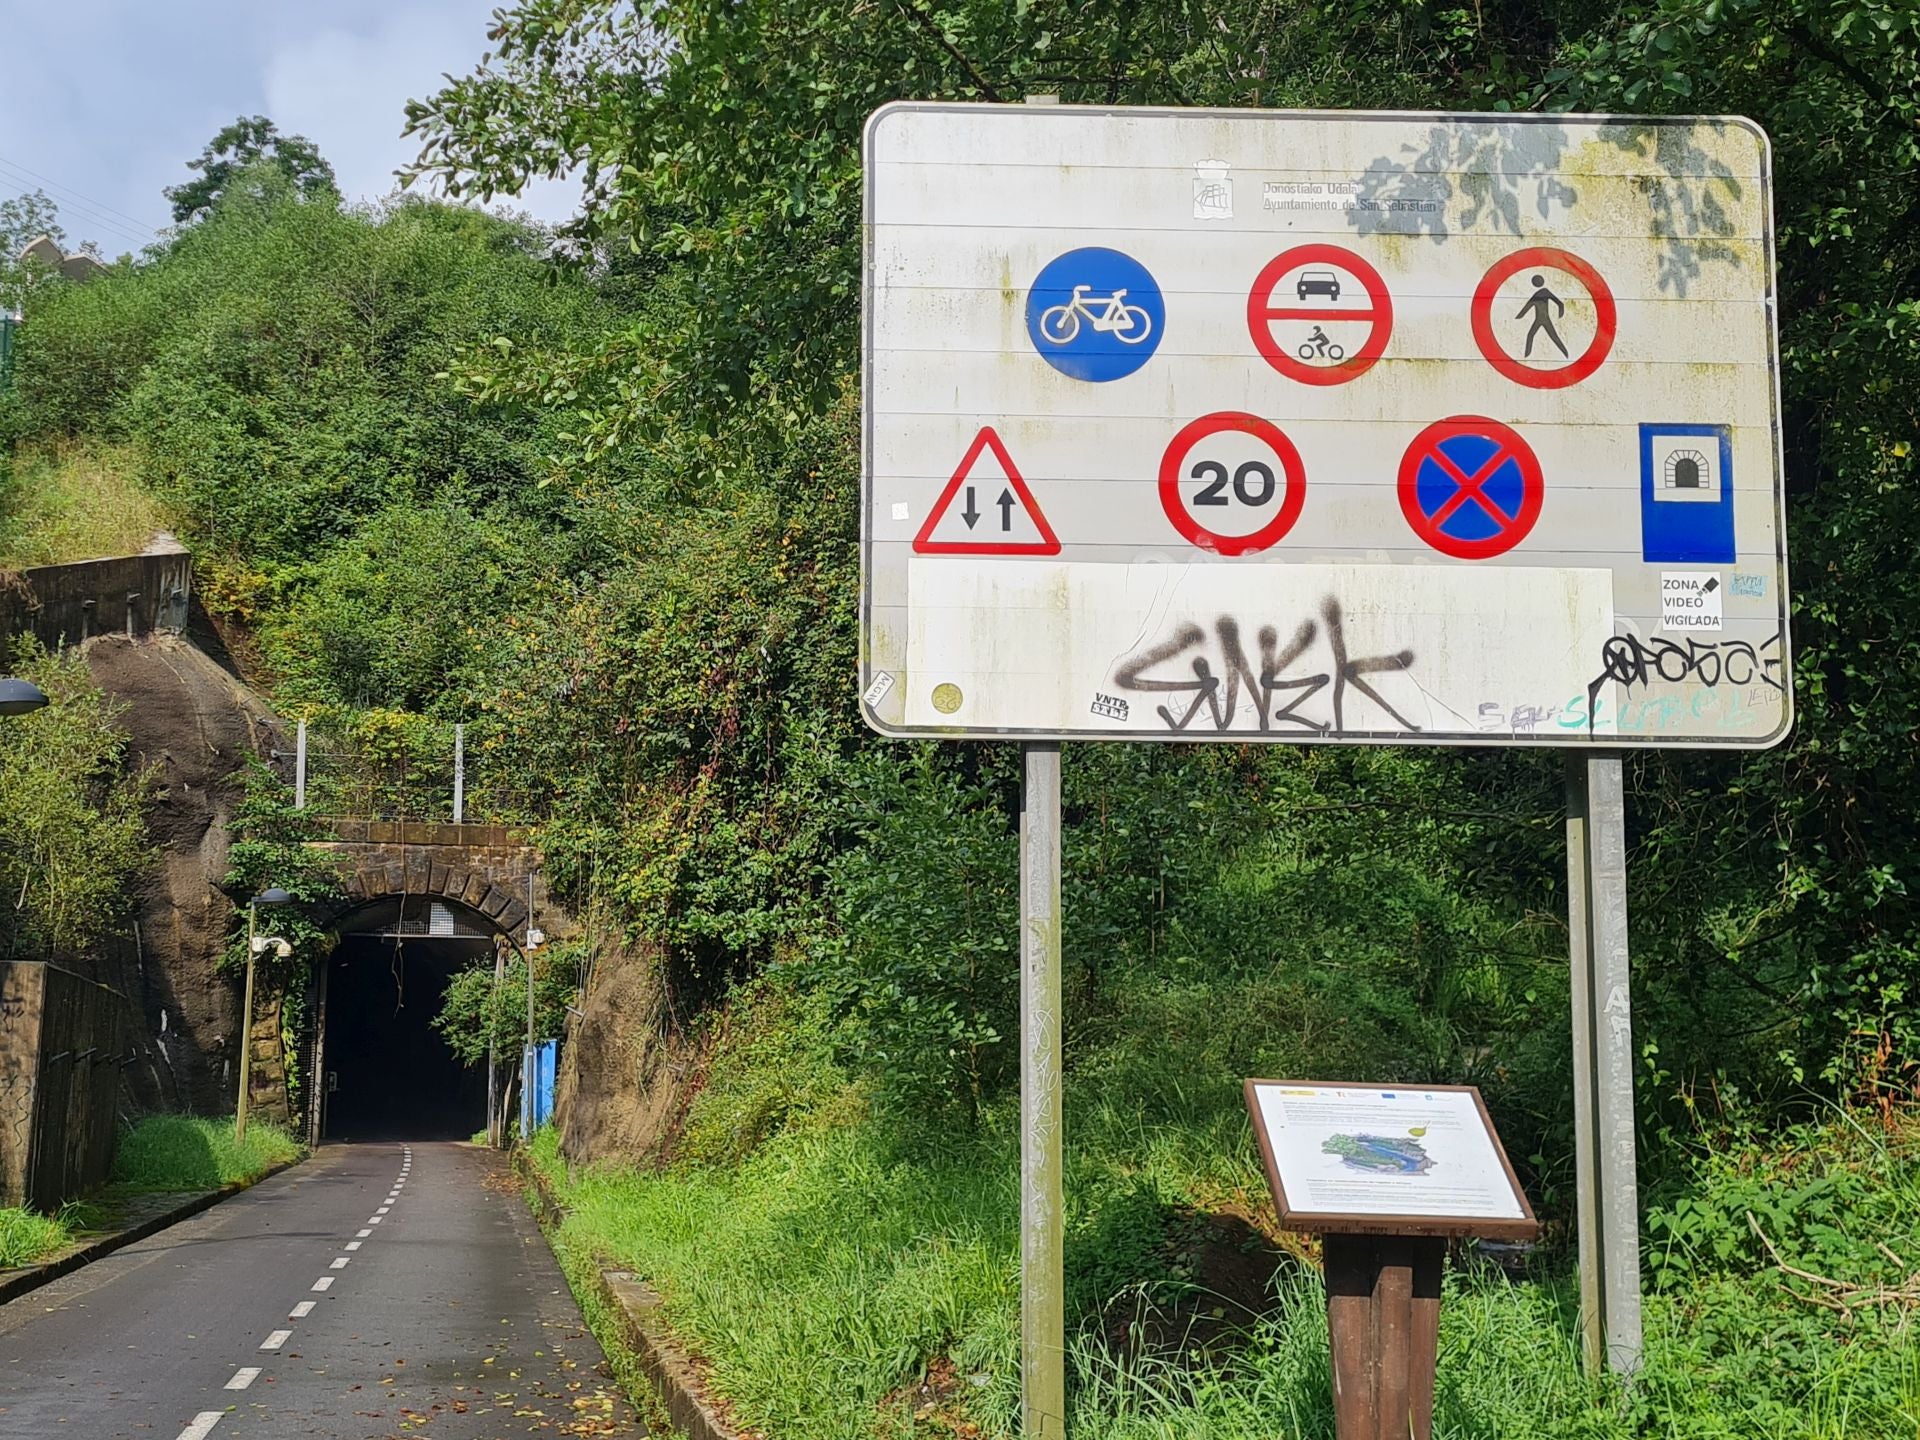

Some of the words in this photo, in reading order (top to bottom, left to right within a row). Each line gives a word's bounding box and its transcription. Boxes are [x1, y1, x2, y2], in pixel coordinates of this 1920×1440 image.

[1263, 182, 1323, 194] Donostiako
[1264, 198, 1337, 214] Ayuntamiento
[1342, 198, 1356, 210] de
[1360, 199, 1380, 211] San
[1191, 460, 1275, 507] 20
[1663, 579, 1700, 590] ZONA
[1664, 597, 1704, 608] VIDEO
[1664, 614, 1720, 626] VIGILADA
